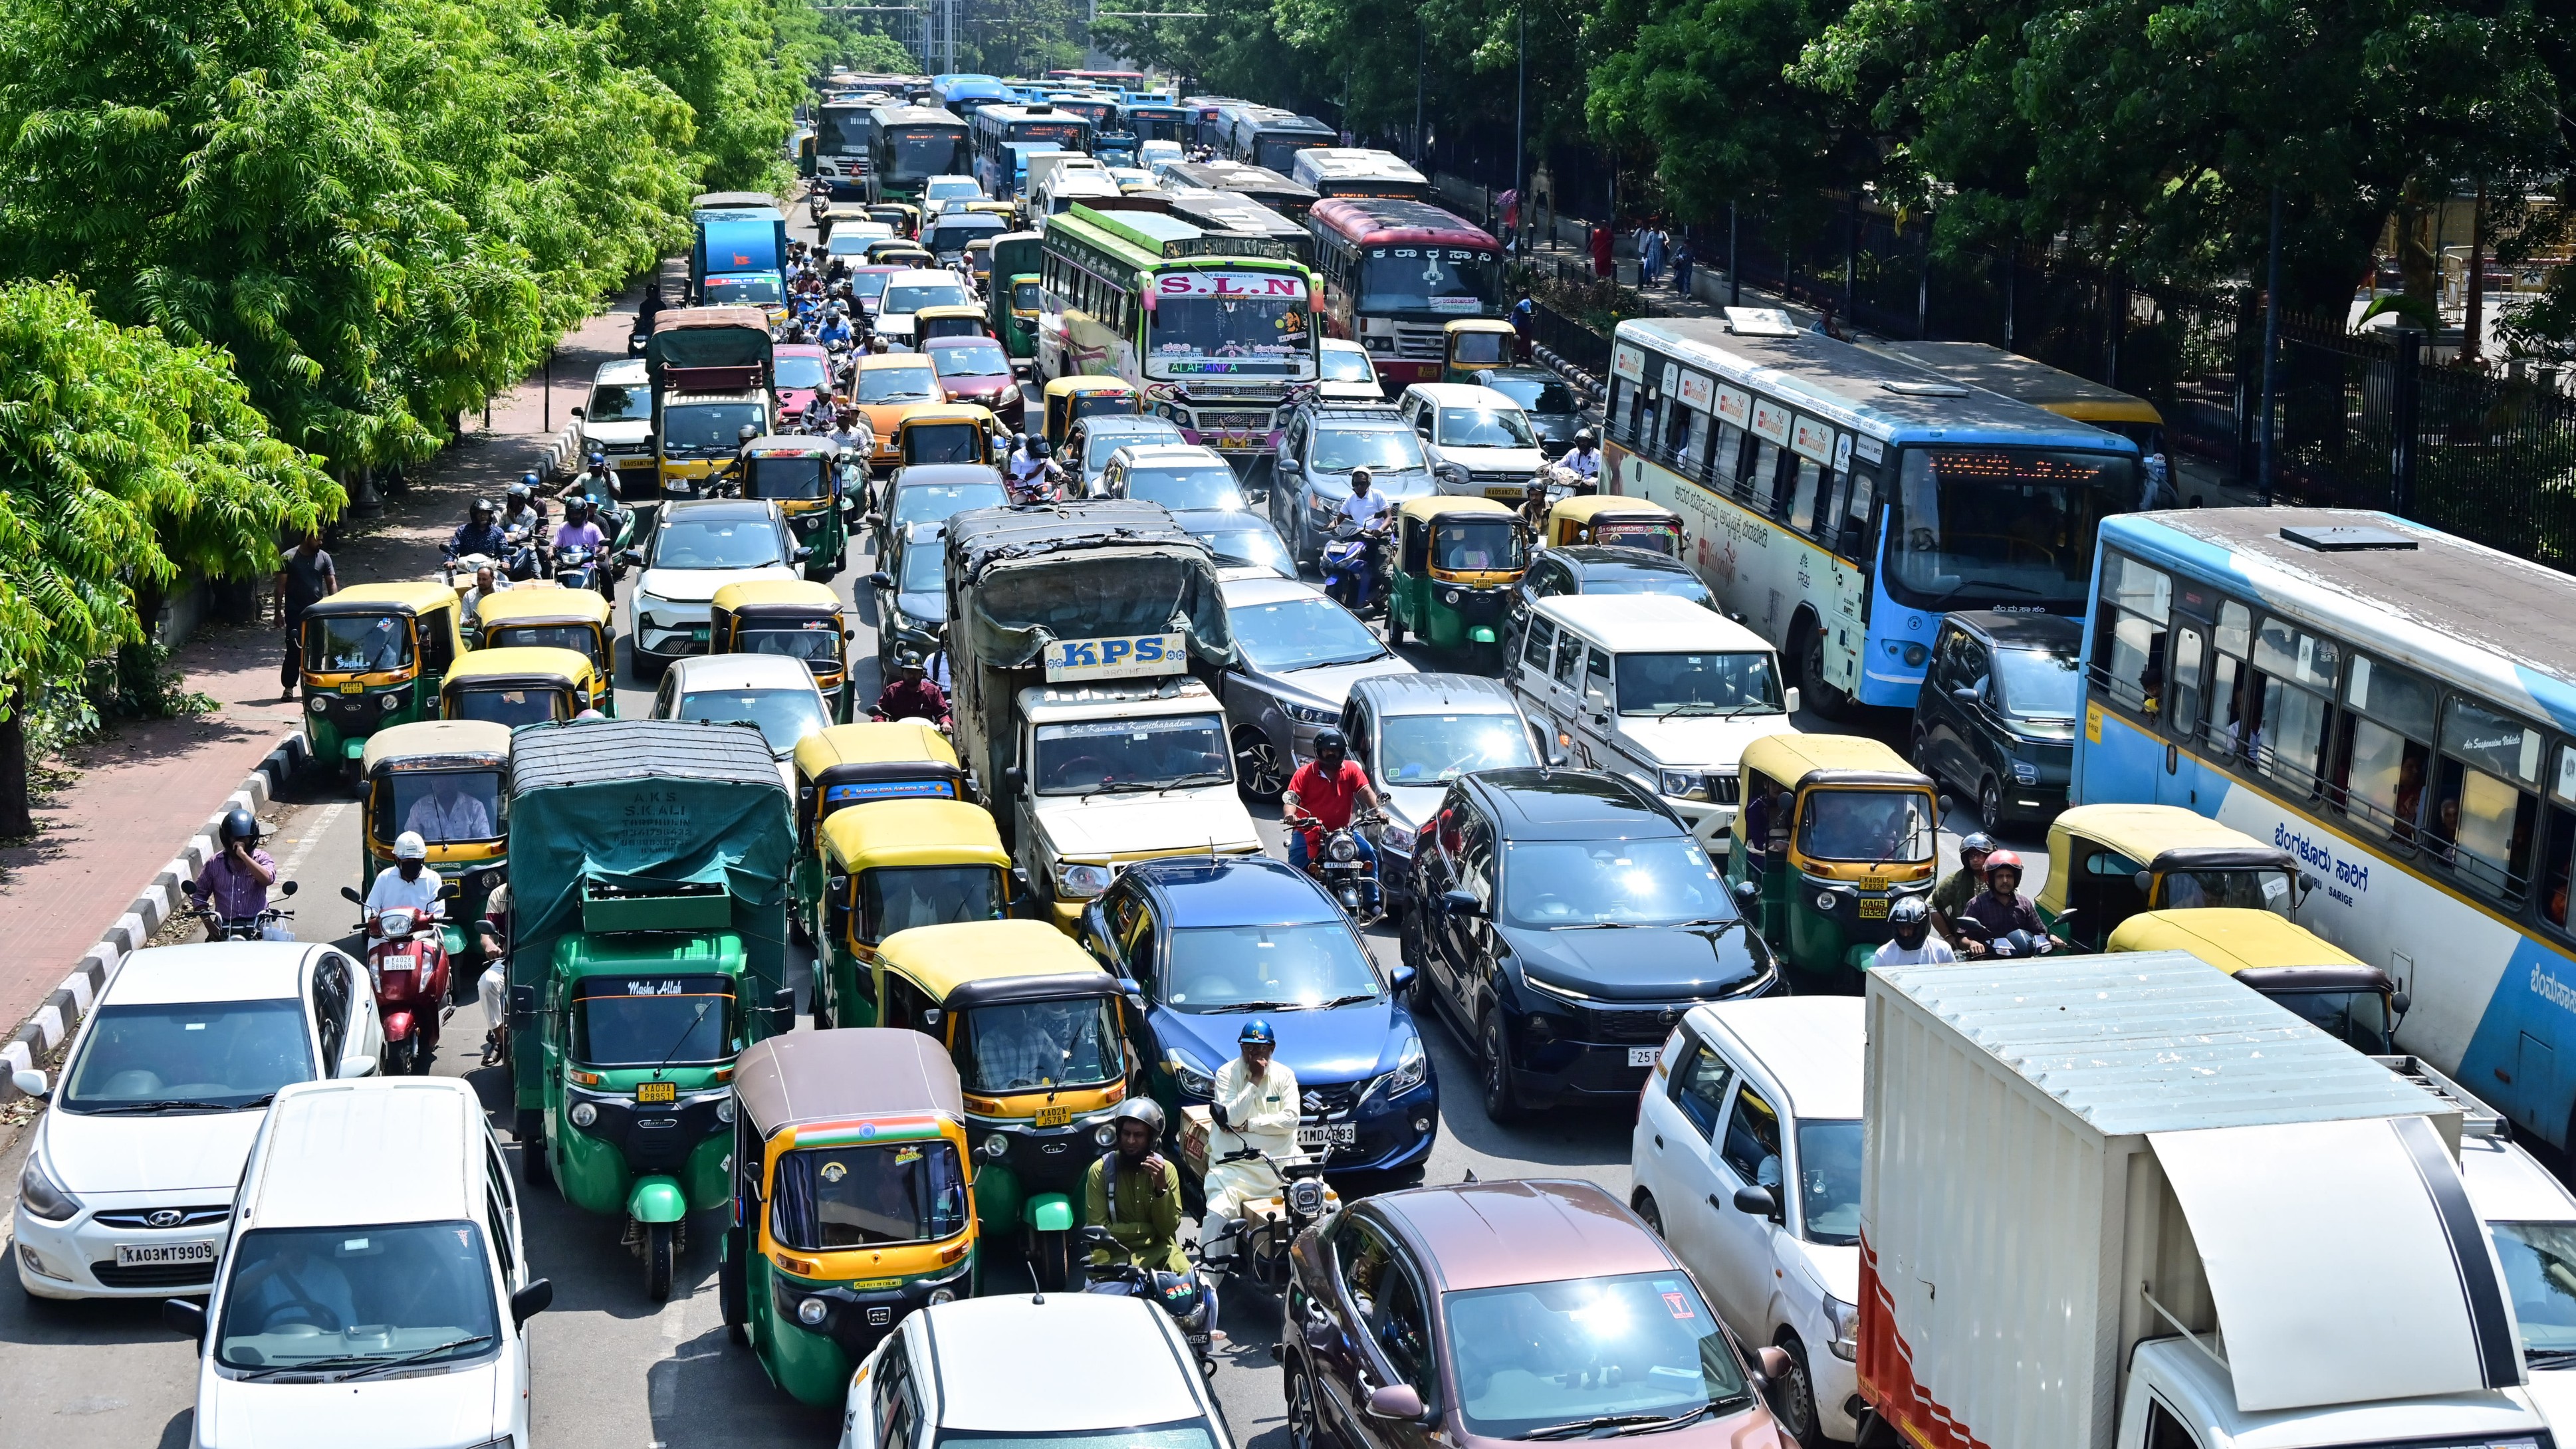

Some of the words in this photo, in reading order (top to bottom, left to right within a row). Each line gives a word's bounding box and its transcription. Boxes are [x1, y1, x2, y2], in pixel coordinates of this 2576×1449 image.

[1161, 277, 1298, 296] S.L.N
[1763, 412, 1784, 439] Vatsalya
[1804, 429, 1825, 457] Vatsalya
[1675, 485, 1690, 505] ಅವರ
[1743, 519, 1768, 548] ಬಿಡಬೇಡಿ
[1706, 541, 1736, 583] Vatsalya
[1843, 605, 1853, 617] BMTC
[1063, 637, 1165, 670] KPS
[1104, 667, 1155, 679] BROTHERS
[1070, 724, 1084, 734] Sri
[2463, 739, 2473, 750] Air
[2473, 738, 2502, 752] Suspension
[2502, 734, 2520, 746] Vehicle
[2275, 822, 2331, 873] ಬೆಂಗಳೂರು
[2335, 859, 2369, 893] ಸಾರಿಗೆ
[2328, 886, 2353, 908] SARIGE
[628, 981, 655, 996] Masha
[657, 980, 682, 996] Allah
[1637, 1051, 1650, 1063] 25
[1042, 1108, 1067, 1117] KA02A
[1042, 1116, 1068, 1125] J5787
[126, 1245, 212, 1263] KA03MT9909
[1165, 1283, 1193, 1300] 313
[872, 1313, 887, 1322] RE
[1191, 1335, 1207, 1343] 4054
